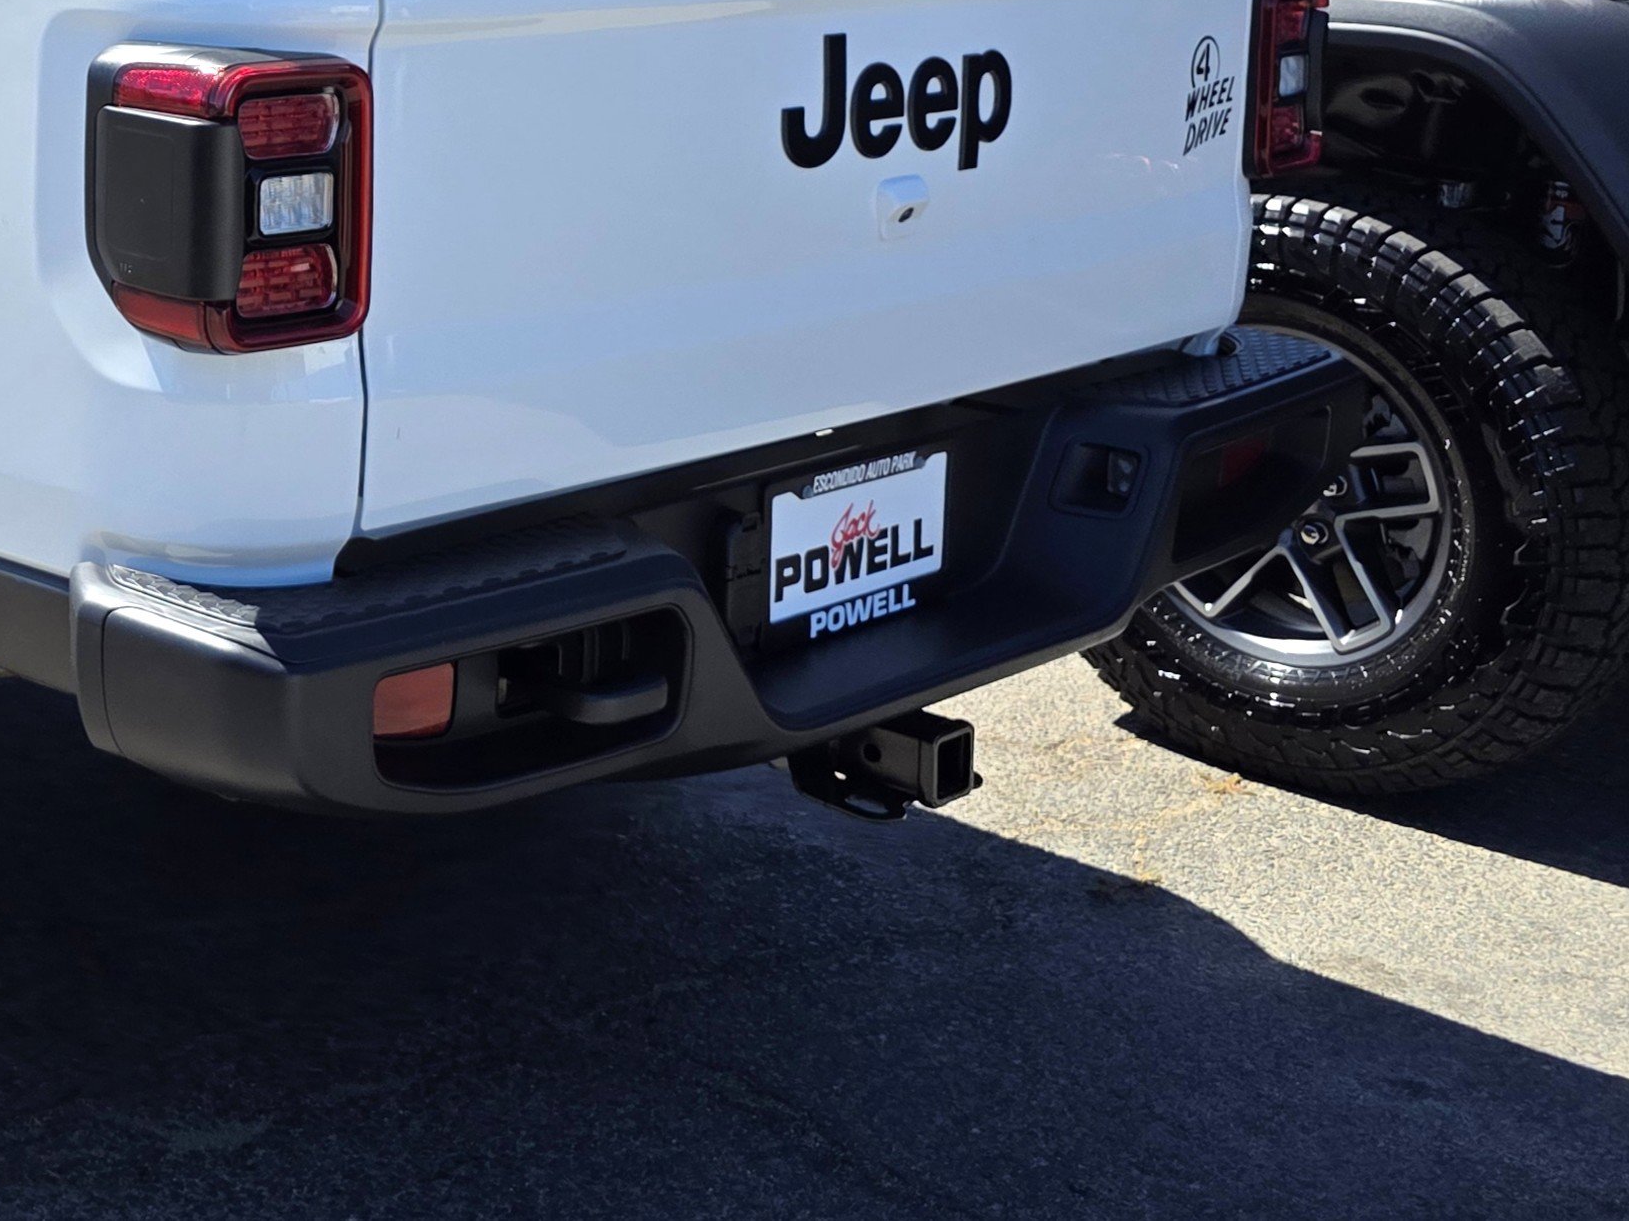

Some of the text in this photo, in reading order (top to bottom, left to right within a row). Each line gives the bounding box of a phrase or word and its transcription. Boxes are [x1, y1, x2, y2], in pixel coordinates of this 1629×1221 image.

[780, 32, 1012, 171] Jeep
[1185, 76, 1235, 122] WHEEL
[1183, 106, 1232, 157] DRIVE
[813, 451, 917, 494] ESCONDIDO AUTO PARK
[774, 518, 934, 603] POWELL
[831, 499, 881, 570] Jack
[809, 583, 916, 639] POWELL
